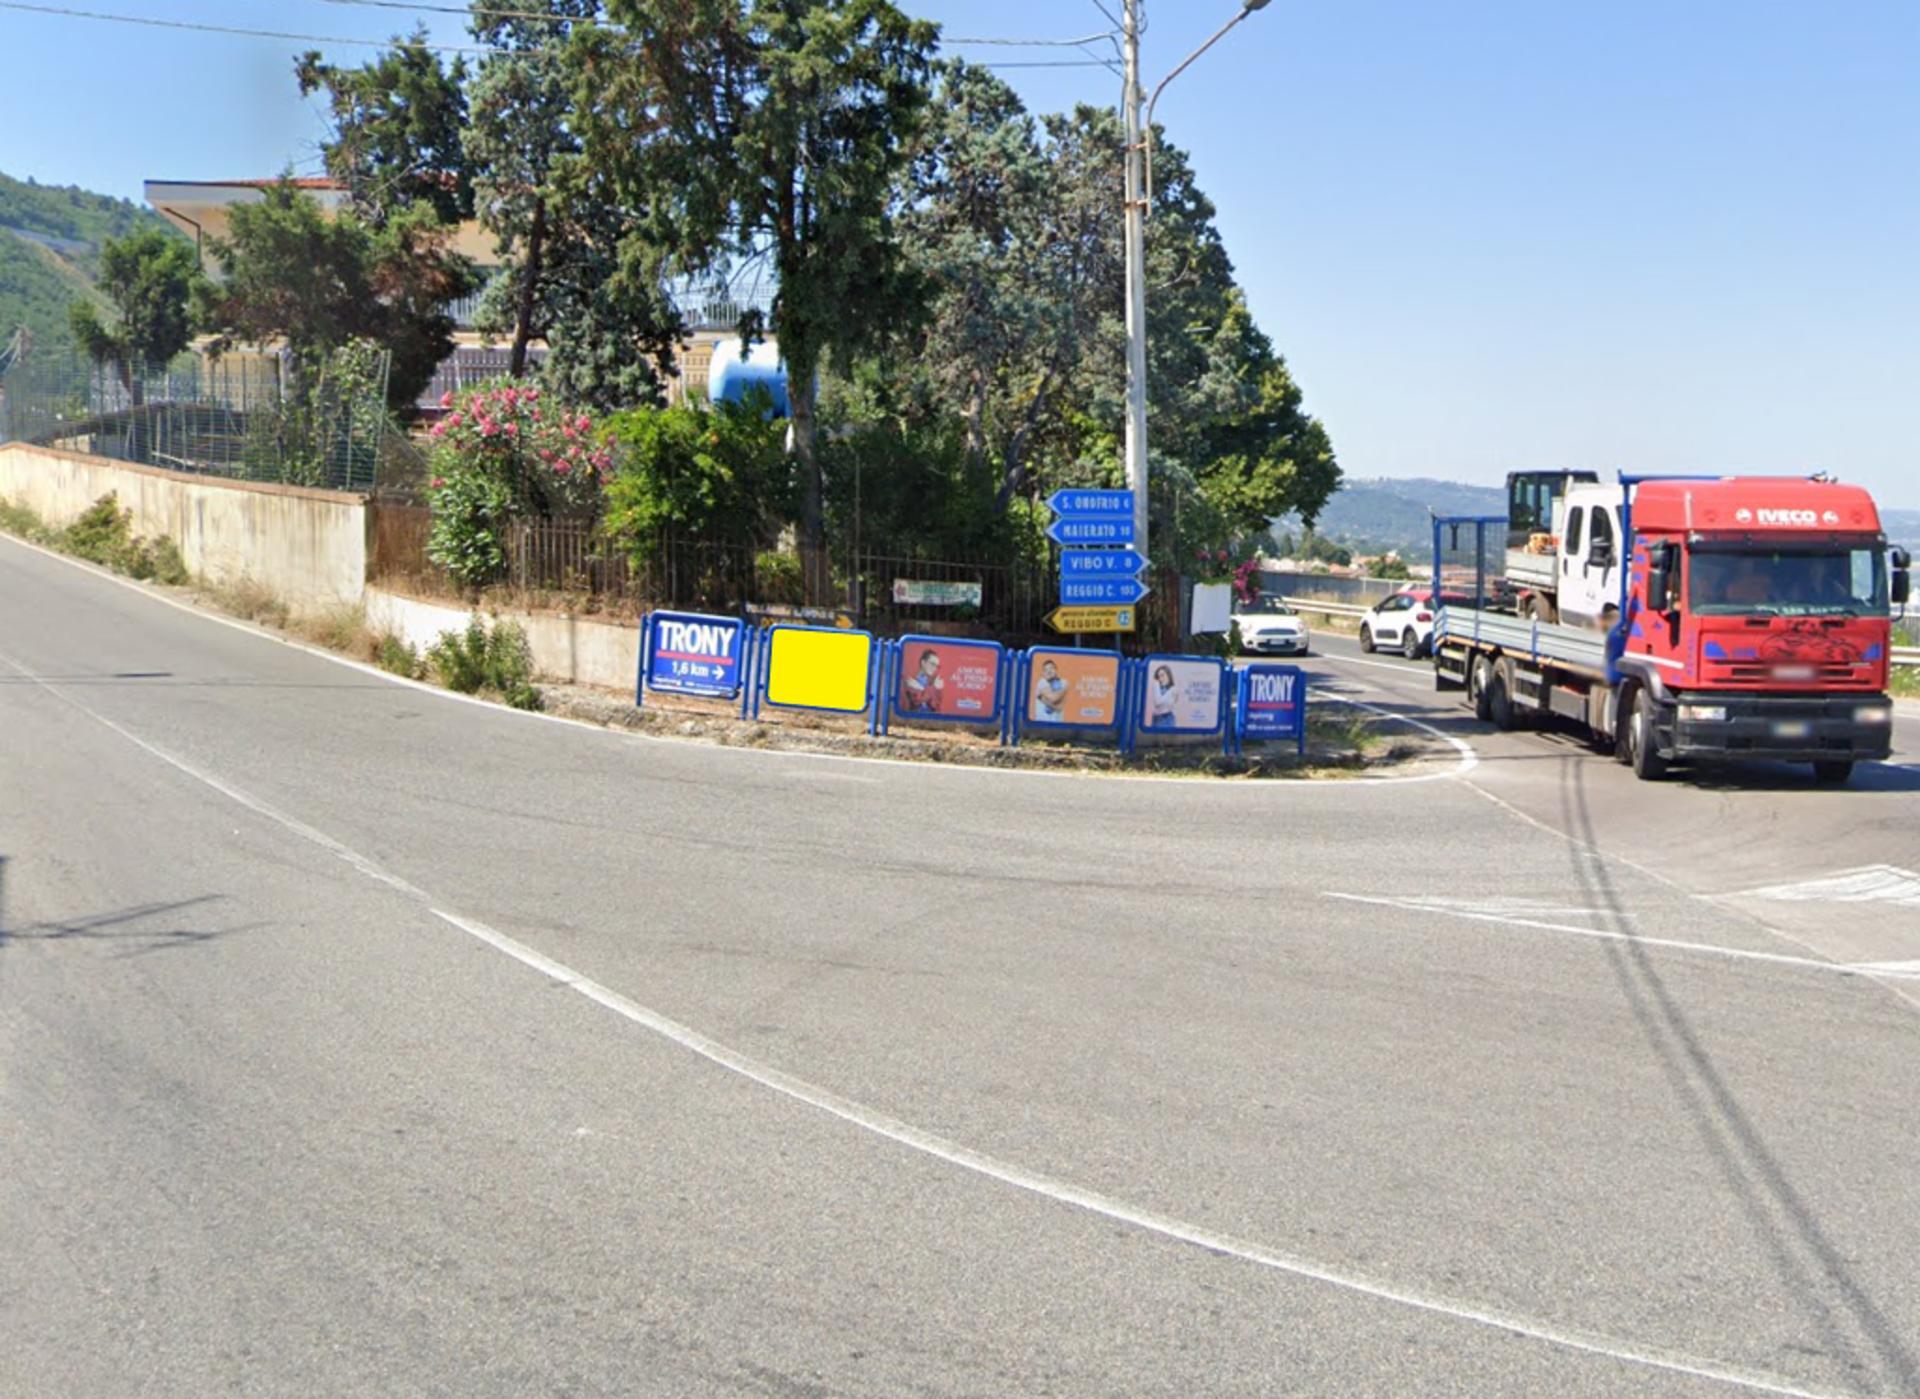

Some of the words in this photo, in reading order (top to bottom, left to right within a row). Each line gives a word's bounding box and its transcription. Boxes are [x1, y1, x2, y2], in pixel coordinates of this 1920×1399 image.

[1062, 497, 1072, 509] S.
[1074, 496, 1120, 509] ONOFRIO
[1757, 509, 1817, 523] IVECO
[1063, 524, 1116, 537] MAIERATO
[1070, 557, 1103, 570] VIBO
[1066, 584, 1104, 597] REGGIO
[659, 620, 735, 657] TRONY
[672, 660, 689, 676] 1,6
[691, 662, 709, 677] km
[1250, 674, 1296, 702] TRONY
